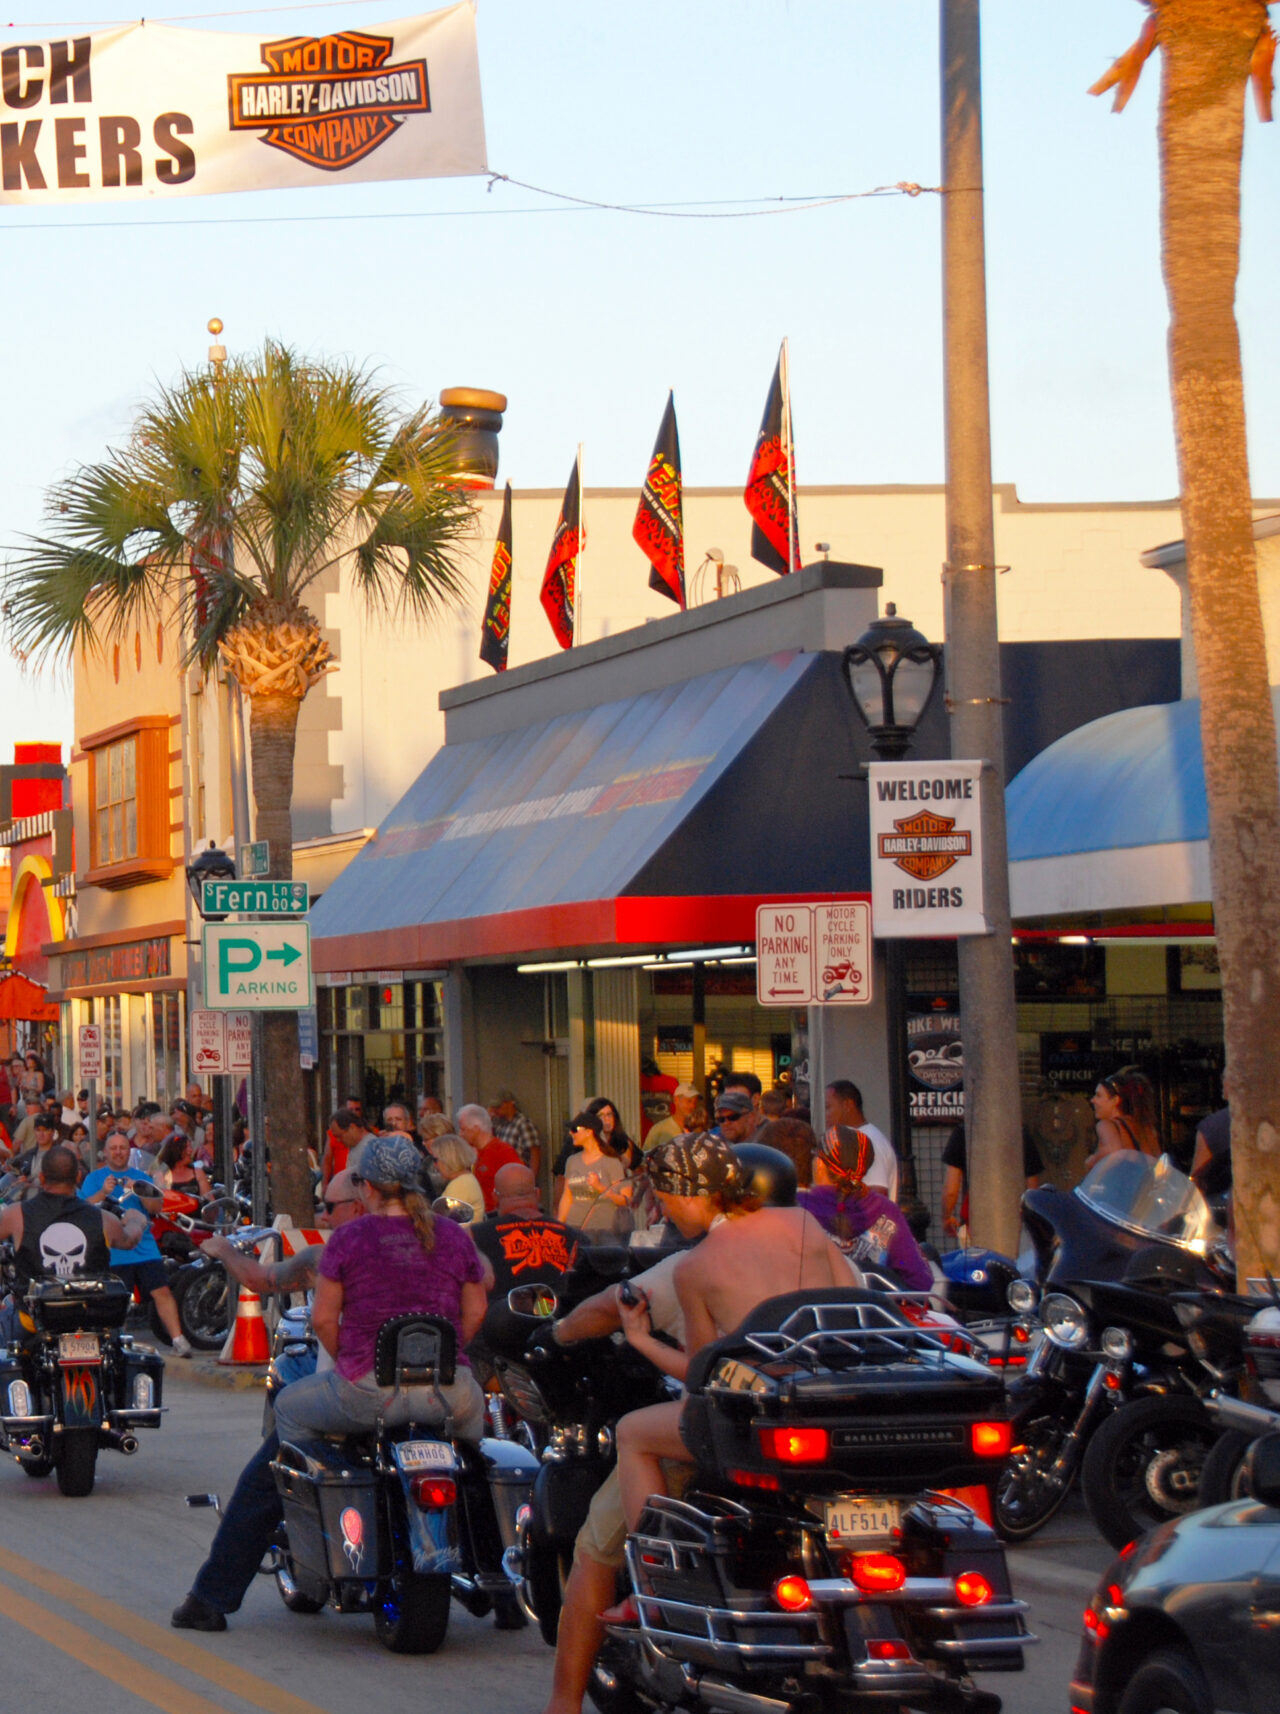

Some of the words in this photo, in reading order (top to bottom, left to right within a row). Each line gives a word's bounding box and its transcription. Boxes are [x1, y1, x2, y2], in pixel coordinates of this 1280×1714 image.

[282, 35, 376, 73] MOTOR
[241, 71, 418, 117] HARLEY-DAVIDSON
[282, 115, 378, 159] COMPANY
[877, 778, 973, 802] WELCOME
[903, 815, 948, 833] MOTOR
[884, 836, 967, 853] HARLEY-DAVIDSON
[903, 856, 949, 876] COMPANY
[206, 883, 214, 897] S
[215, 885, 267, 910] Fern
[272, 883, 288, 896] Ln
[892, 887, 963, 910] RIDERS
[826, 907, 856, 920] MOTOR
[774, 914, 795, 933] NO
[827, 920, 855, 932] CYCLE
[761, 936, 809, 955] PARKING
[822, 933, 860, 945] PARKING
[830, 946, 852, 958] ONLY
[774, 957, 796, 969] ANY
[773, 971, 799, 984] TIME
[199, 1022, 216, 1030] CYCLE
[235, 1015, 249, 1028] NO
[200, 1037, 215, 1046] ONLY
[237, 1042, 250, 1051] ANY
[844, 1431, 954, 1442] HARLEY-DAVIDSON
[831, 1513, 889, 1531] 4LF514
